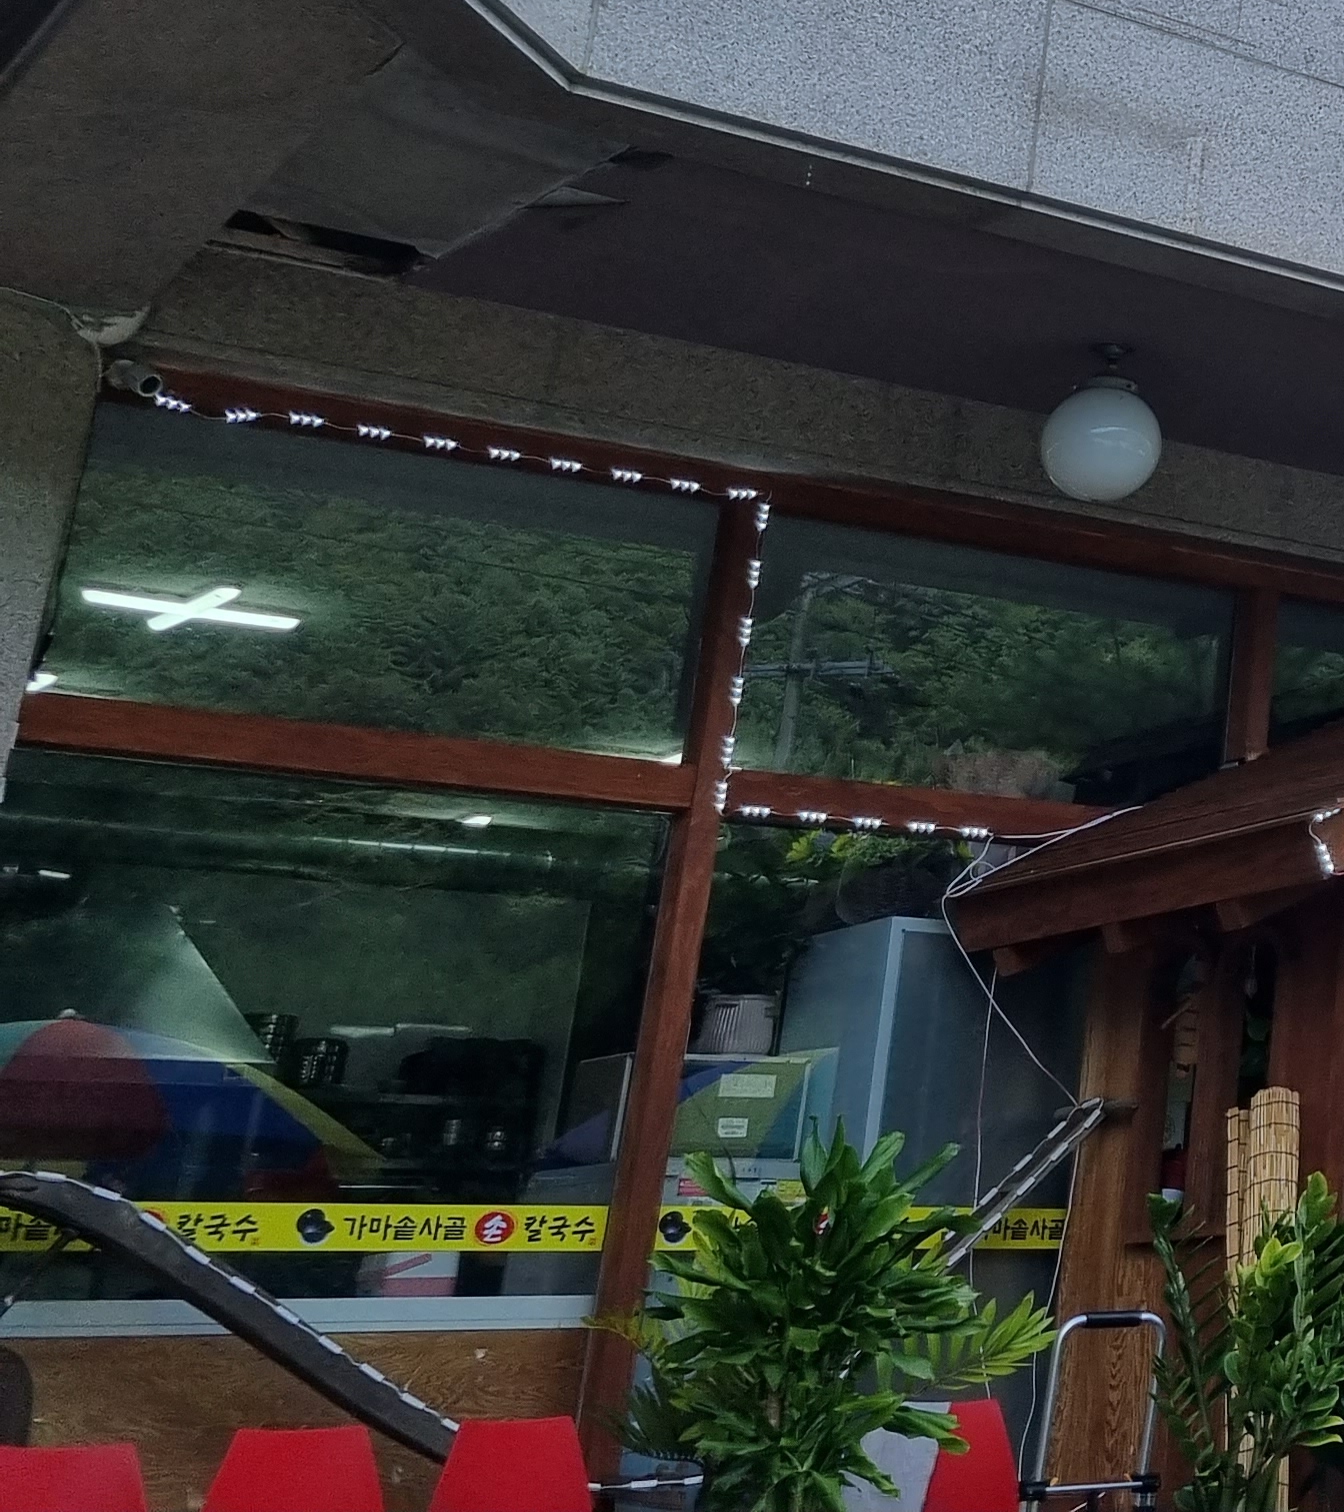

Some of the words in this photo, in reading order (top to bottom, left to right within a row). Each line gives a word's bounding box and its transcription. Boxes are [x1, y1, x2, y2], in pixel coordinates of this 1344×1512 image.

[176, 1213, 258, 1242] 칼국수
[343, 1214, 467, 1241] 가마솥사골
[482, 1215, 507, 1241] 손
[523, 1215, 596, 1242] 칼국수
[984, 1217, 1065, 1241] 마솥사골
